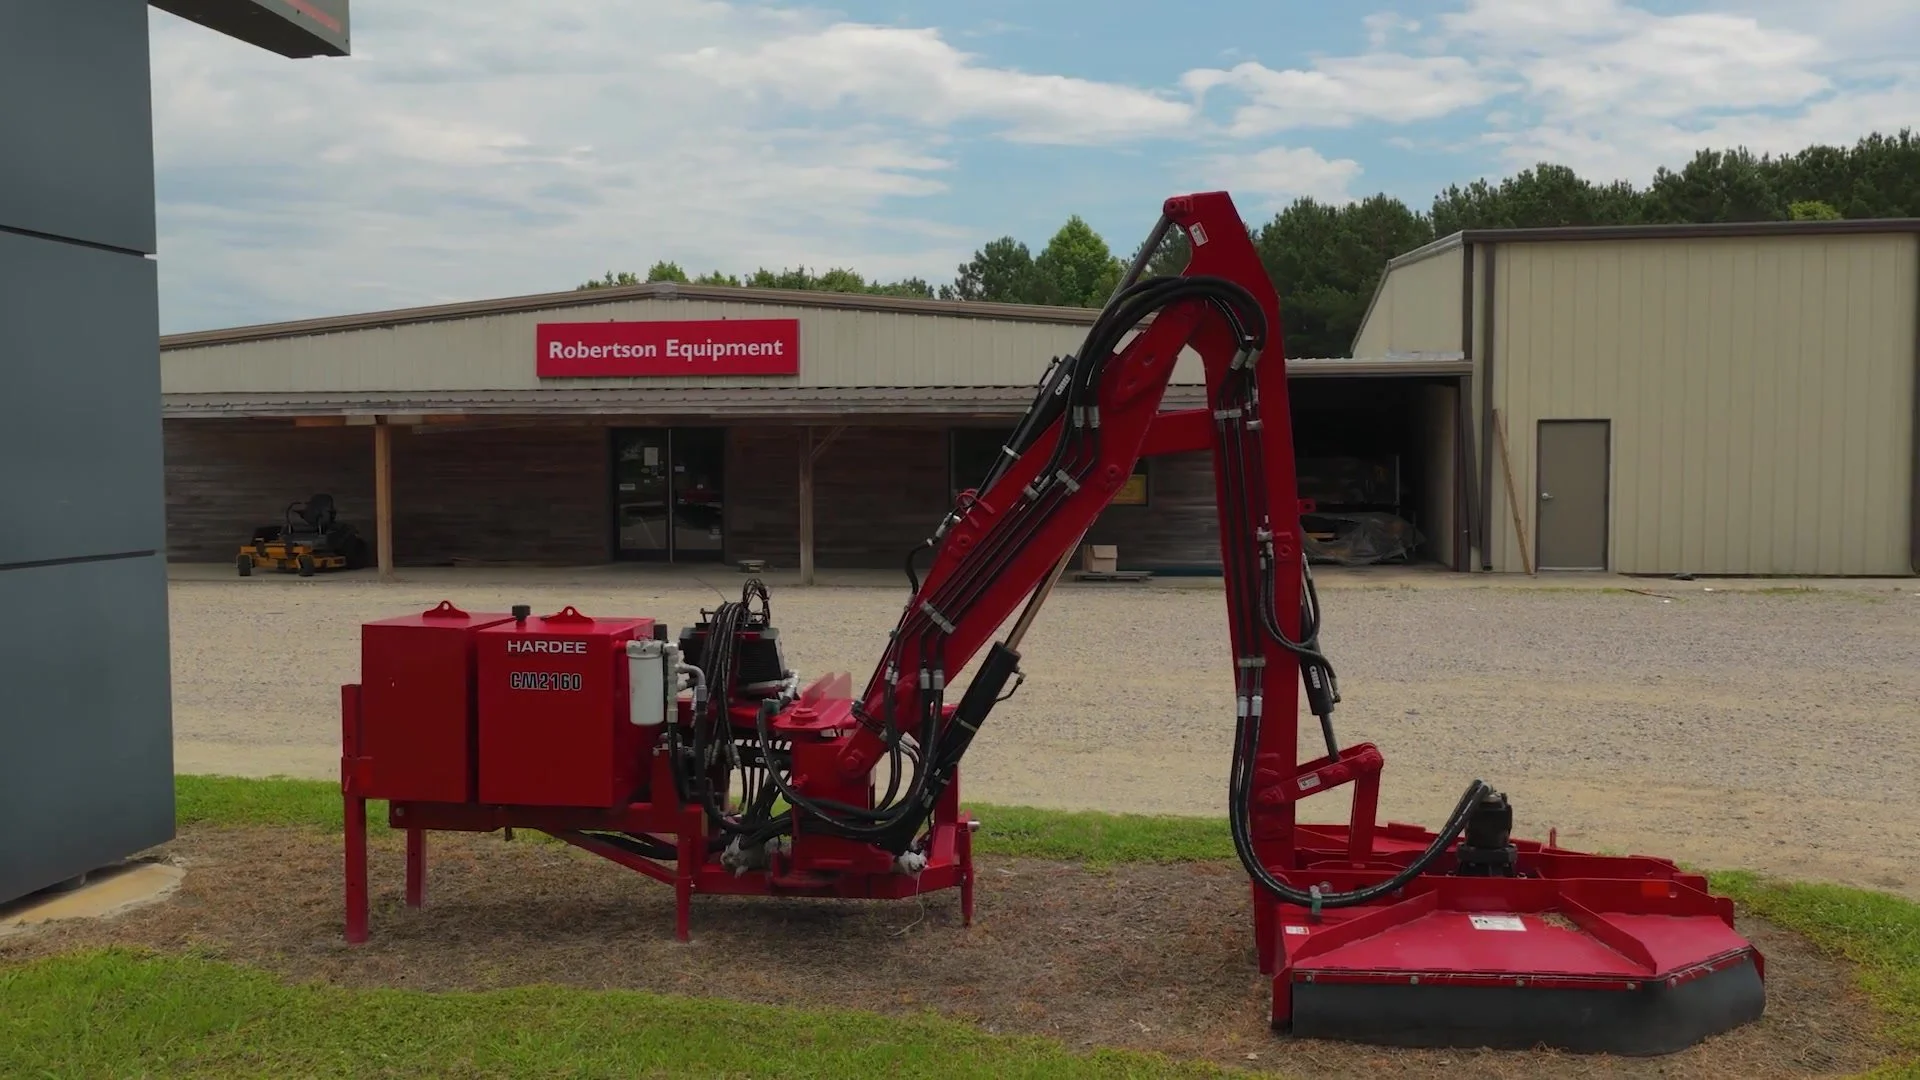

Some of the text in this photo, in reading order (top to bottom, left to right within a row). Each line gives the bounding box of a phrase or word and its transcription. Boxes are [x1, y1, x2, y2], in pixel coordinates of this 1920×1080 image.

[549, 339, 783, 361] Robertson Equipment
[507, 640, 587, 654] HARDEE
[510, 671, 582, 691] CM2160
